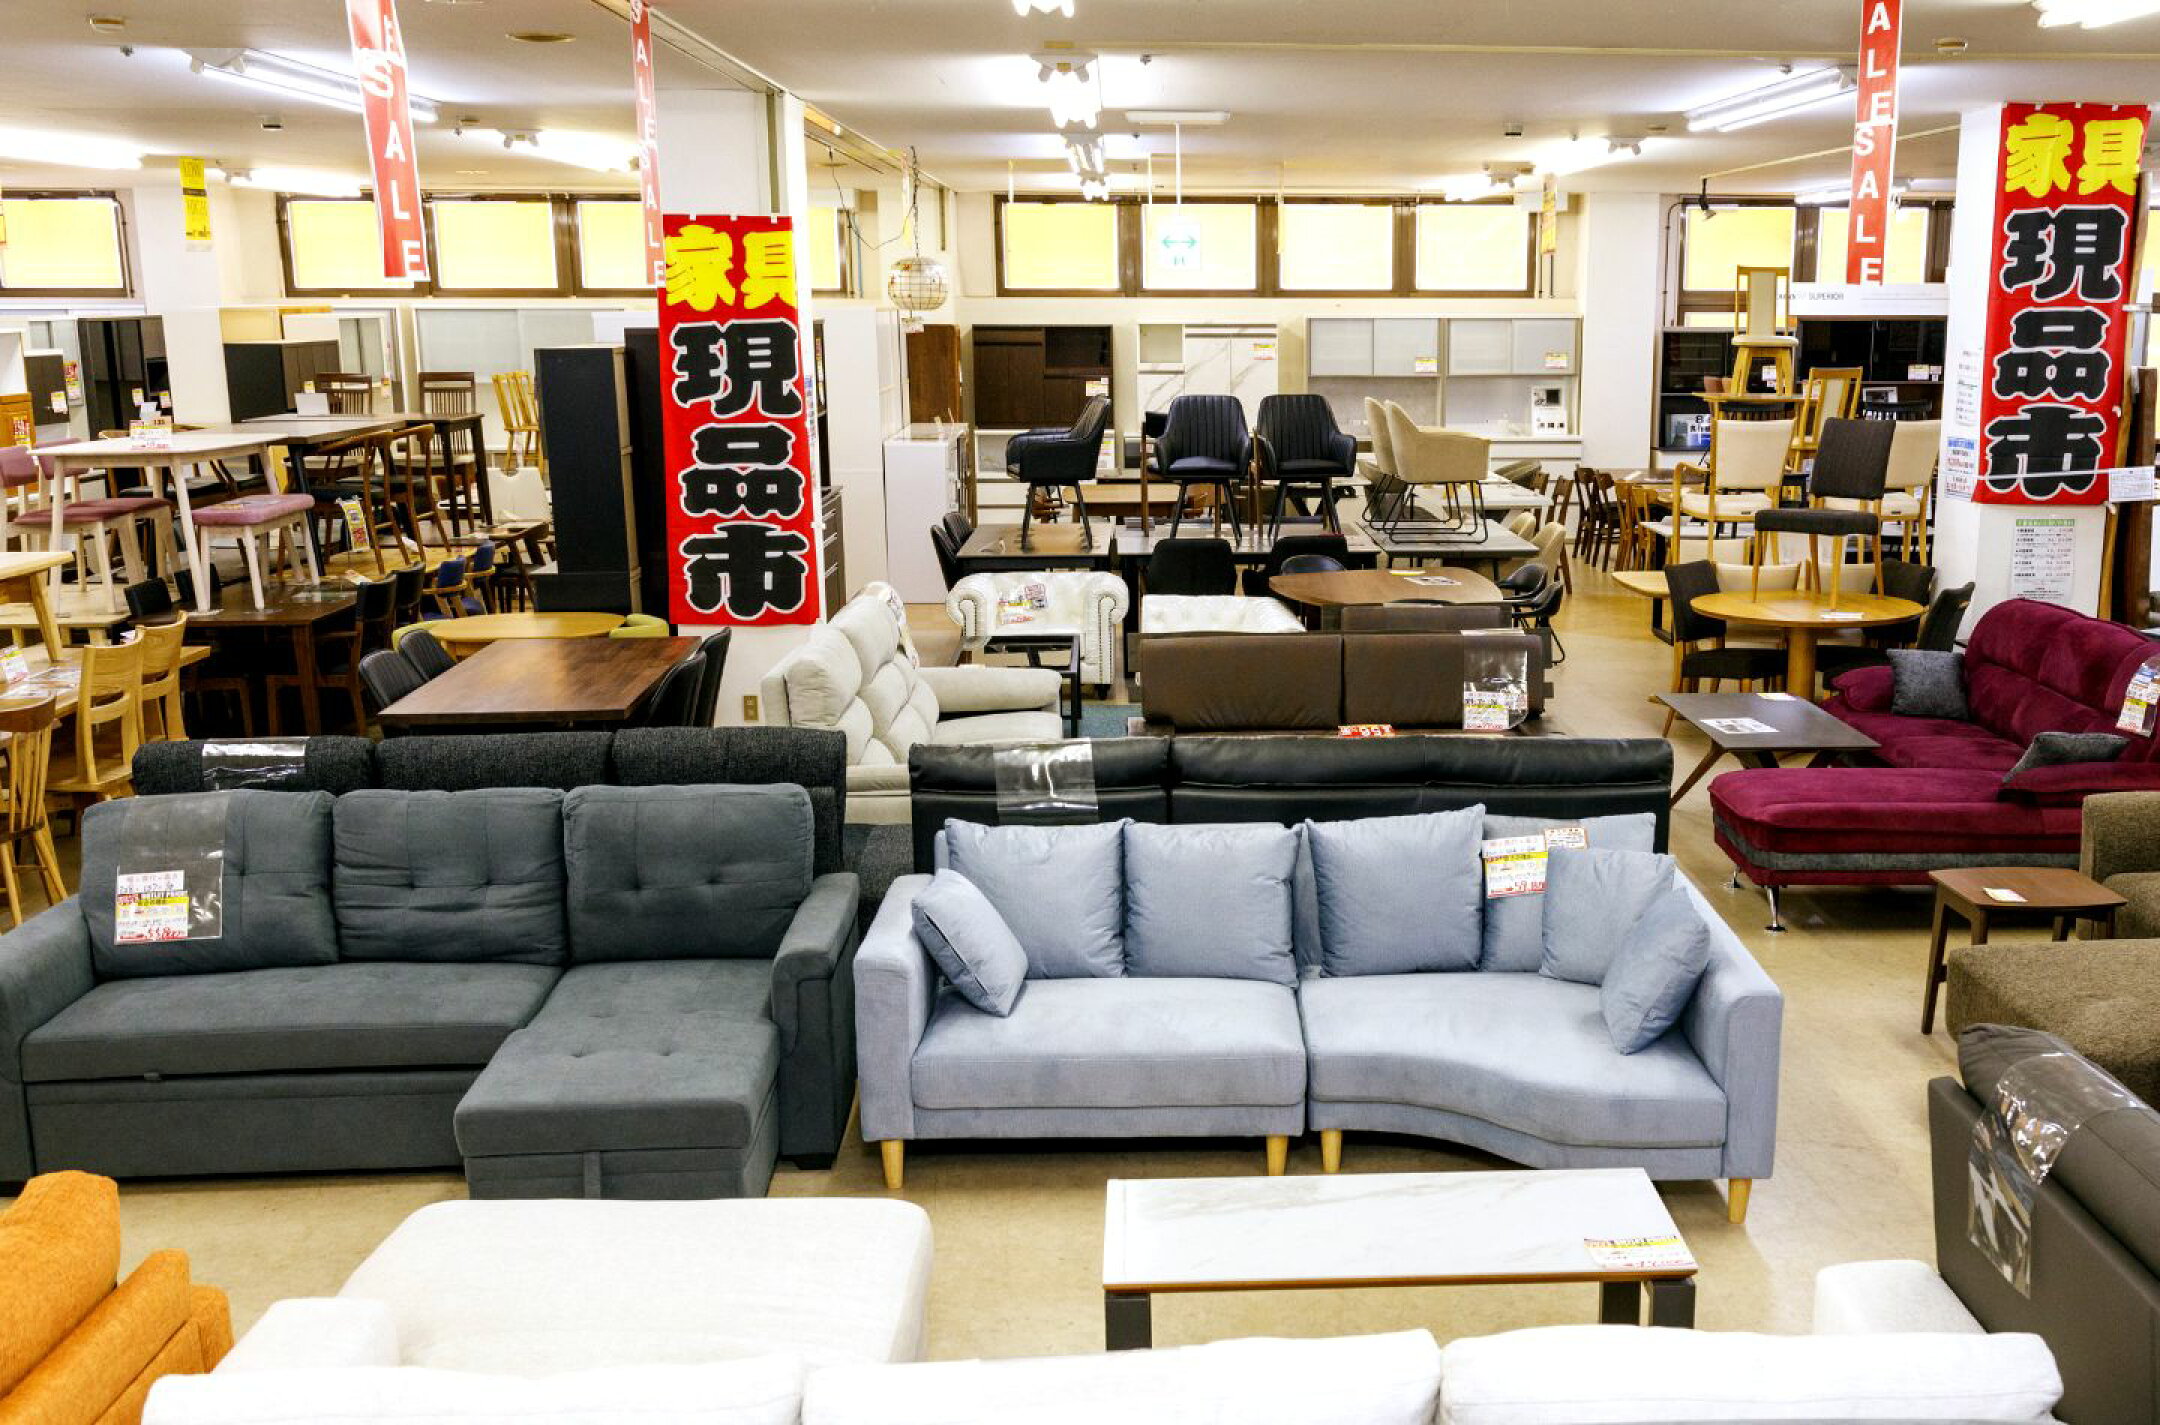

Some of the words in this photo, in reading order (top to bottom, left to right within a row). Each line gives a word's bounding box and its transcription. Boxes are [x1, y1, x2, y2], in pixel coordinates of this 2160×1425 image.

[359, 50, 423, 277] SALE
[1854, 121, 1883, 286] SALE
[2005, 114, 2144, 198] 家具
[665, 225, 798, 312] 家具
[1985, 203, 2128, 500] 現品市
[670, 318, 810, 621] 現品市
